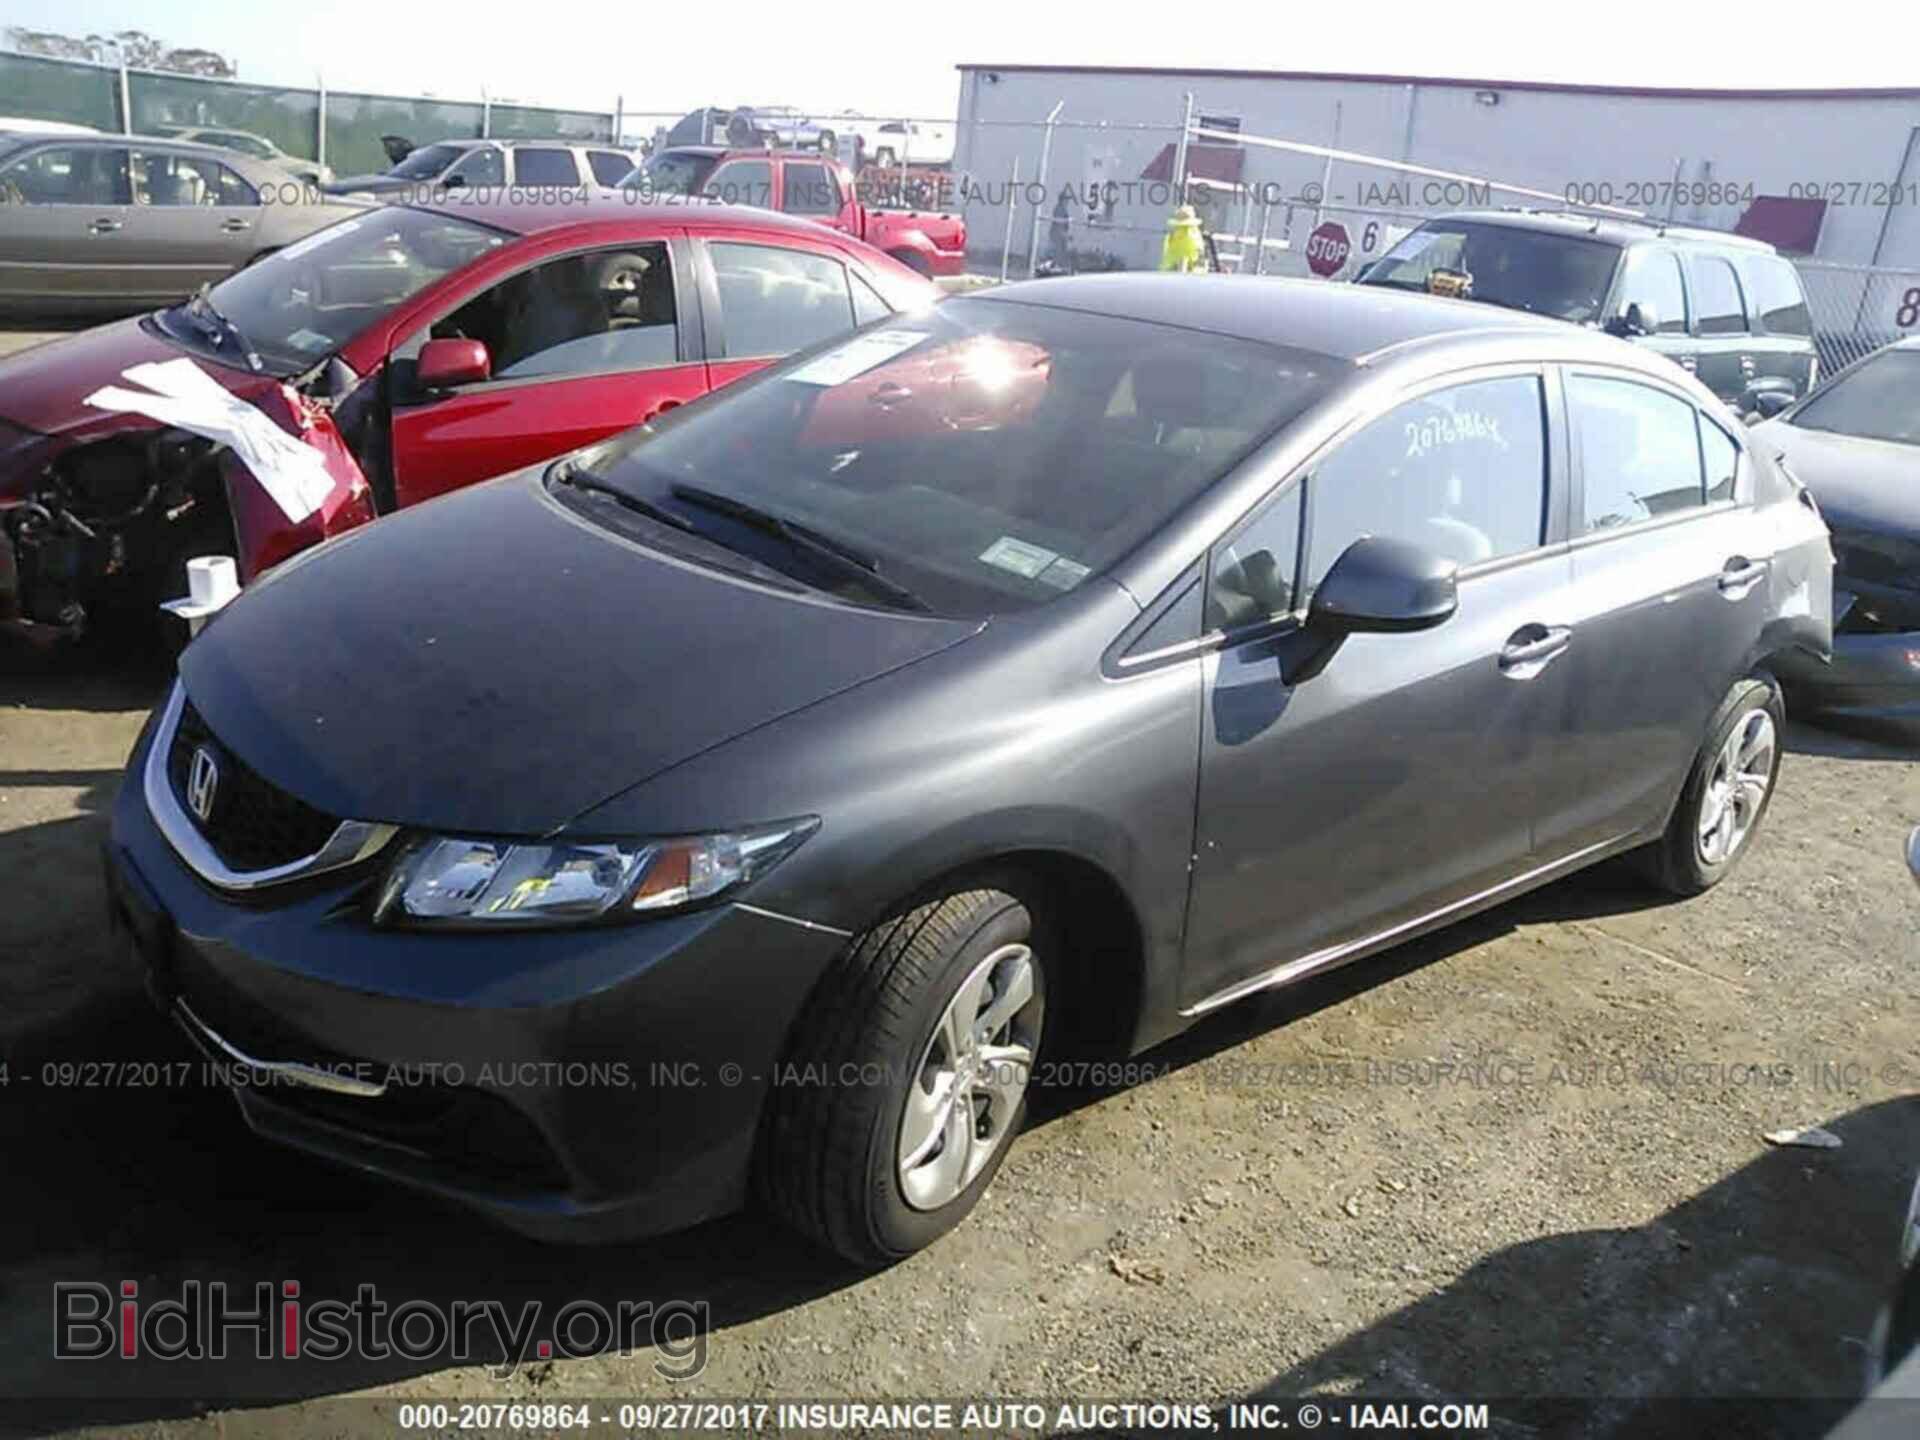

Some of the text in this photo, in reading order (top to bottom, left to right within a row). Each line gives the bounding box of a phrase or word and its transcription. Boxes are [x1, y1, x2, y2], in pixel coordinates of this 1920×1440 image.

[1308, 234, 1348, 263] STOP
[1362, 221, 1379, 253] 6
[1896, 287, 1920, 329] 8
